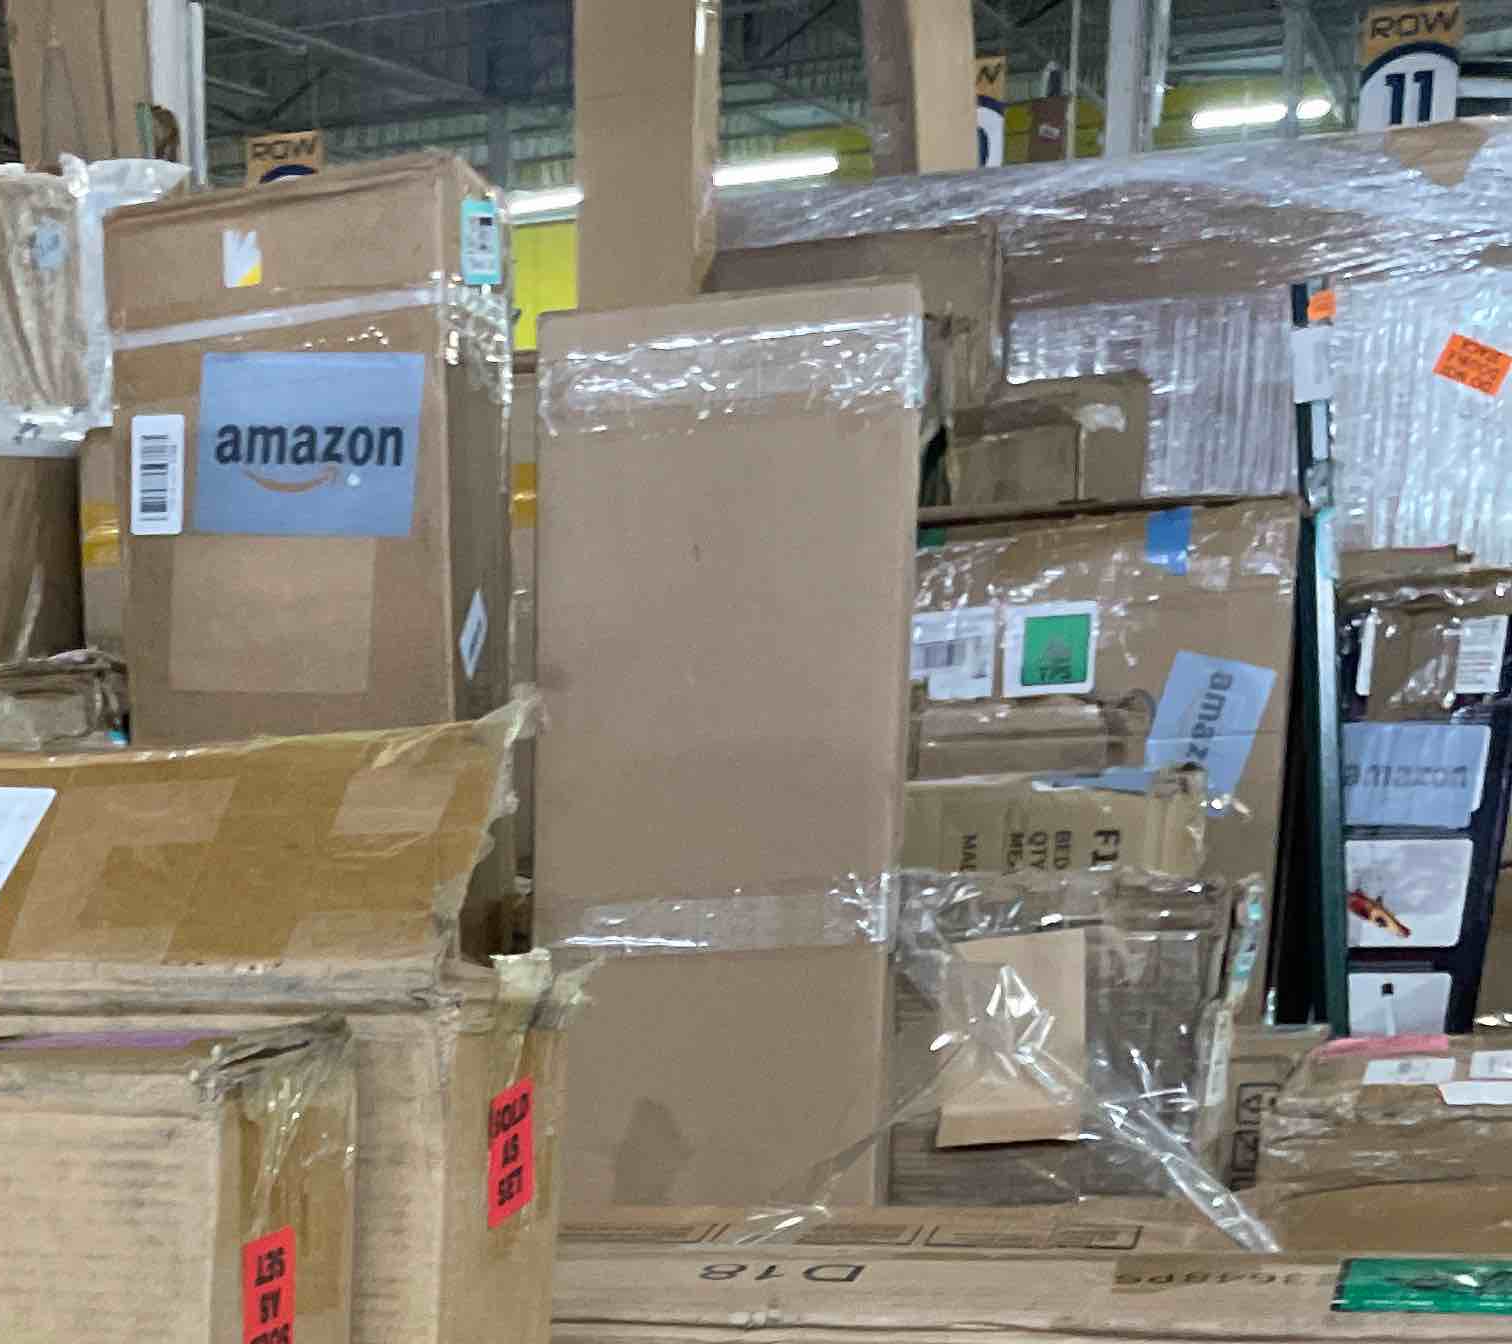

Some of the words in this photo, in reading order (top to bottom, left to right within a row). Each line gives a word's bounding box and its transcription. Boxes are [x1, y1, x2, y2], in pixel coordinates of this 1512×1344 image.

[1369, 6, 1460, 39] ROW
[1384, 69, 1433, 124] 11
[215, 424, 404, 466] amazon
[1186, 671, 1233, 762] amaz
[254, 1247, 285, 1286] SET
